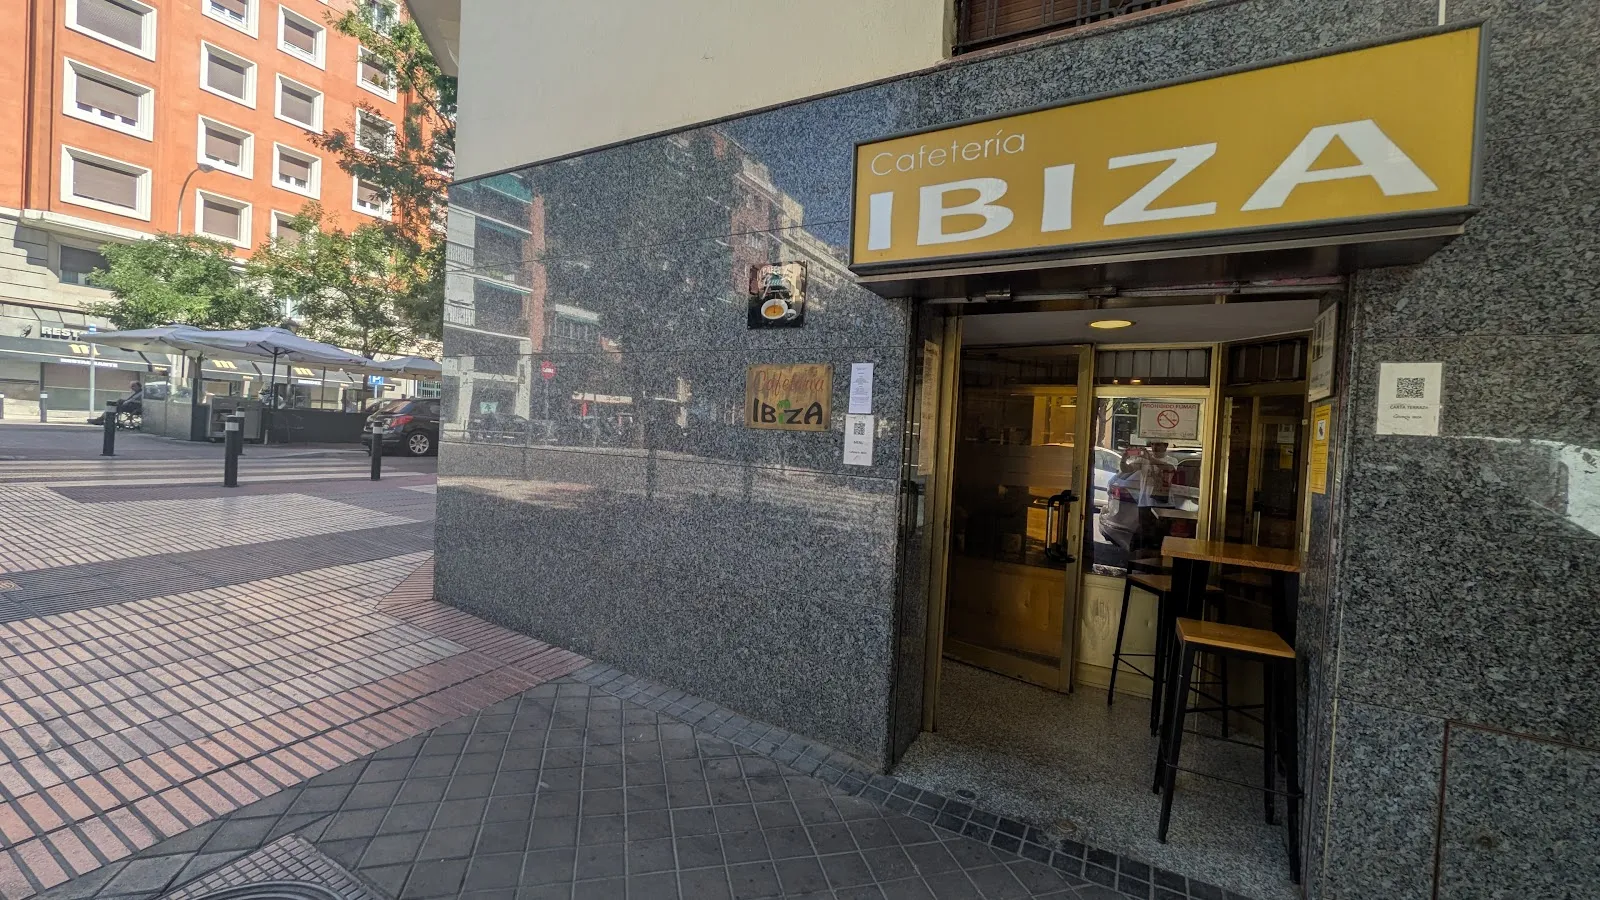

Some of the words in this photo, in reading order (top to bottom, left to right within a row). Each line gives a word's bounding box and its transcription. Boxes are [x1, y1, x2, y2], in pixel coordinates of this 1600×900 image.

[871, 130, 1025, 177] Cafetería
[866, 119, 1439, 252] IBIZA
[41, 326, 88, 338] REST
